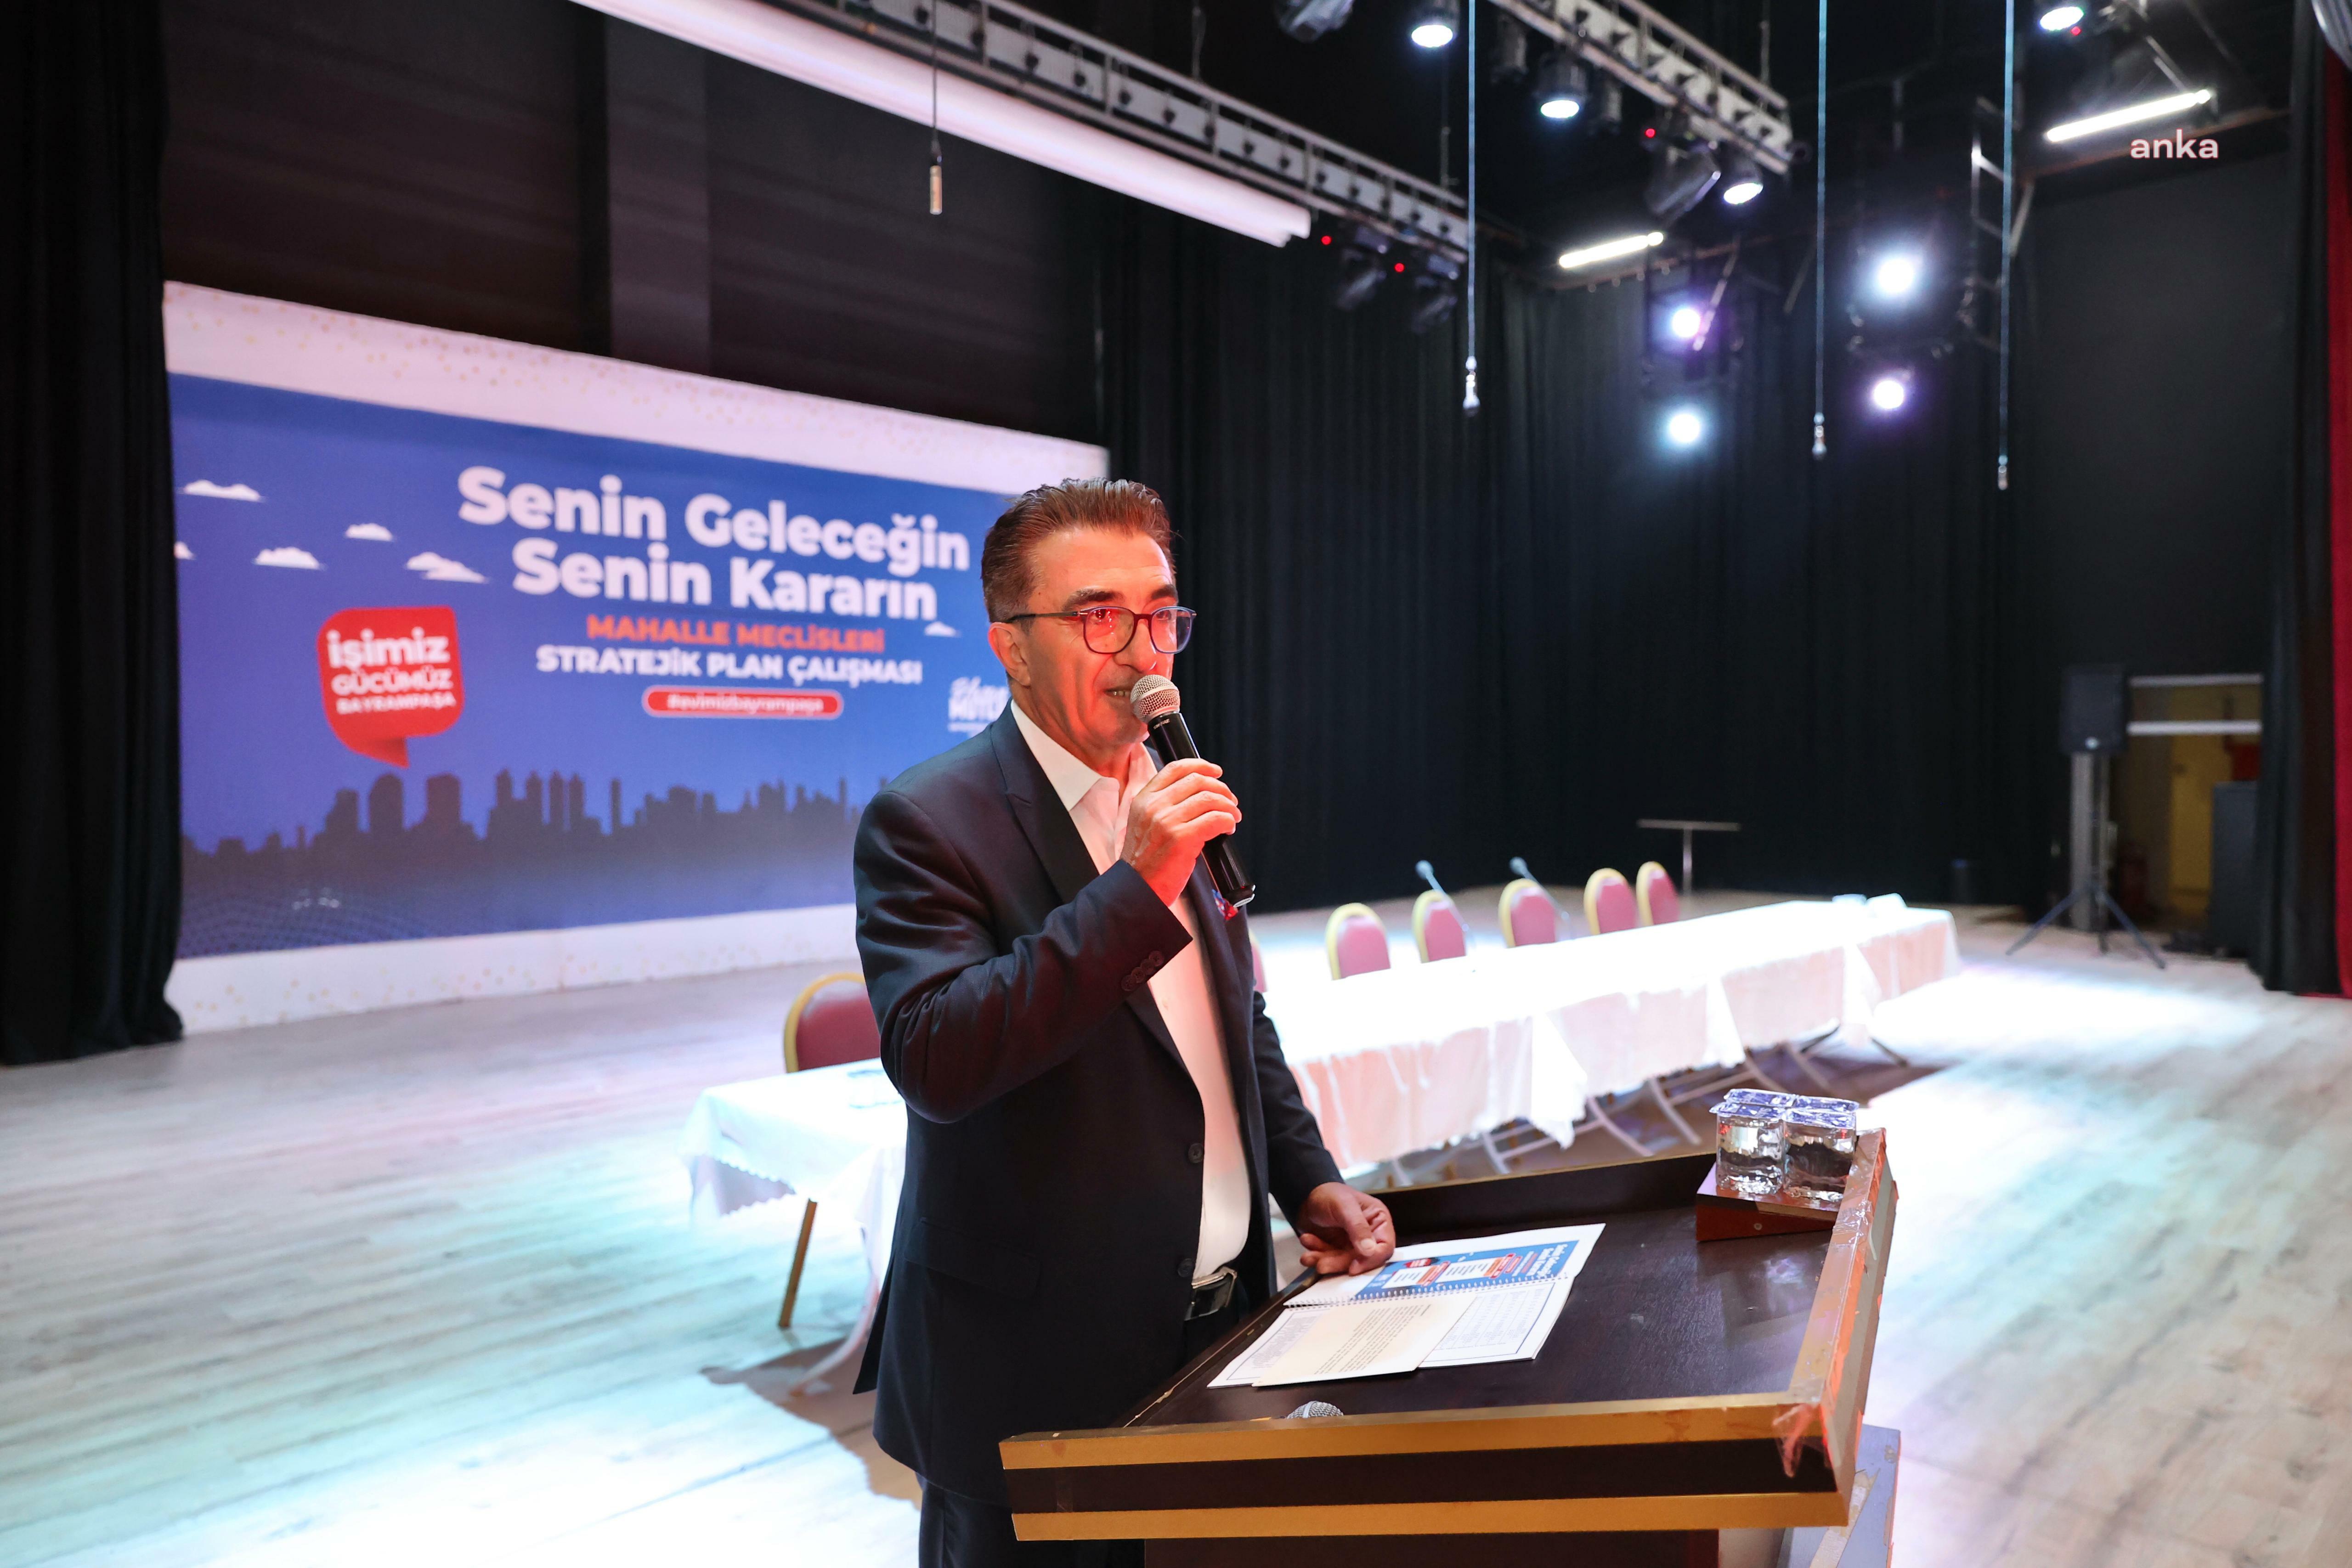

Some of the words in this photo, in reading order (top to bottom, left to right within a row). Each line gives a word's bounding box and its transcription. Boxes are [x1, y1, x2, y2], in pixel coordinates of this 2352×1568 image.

[458, 465, 667, 541] Senin
[684, 493, 970, 577] Geleceğin
[512, 537, 711, 605] Senin
[730, 557, 937, 620] Kararın
[586, 613, 730, 646] MAHALLE
[736, 622, 885, 654] MECLİSLERİ
[536, 644, 702, 677] STRATEJİK
[707, 651, 783, 679] PLAN
[787, 655, 923, 688] ÇALIŞMASI
